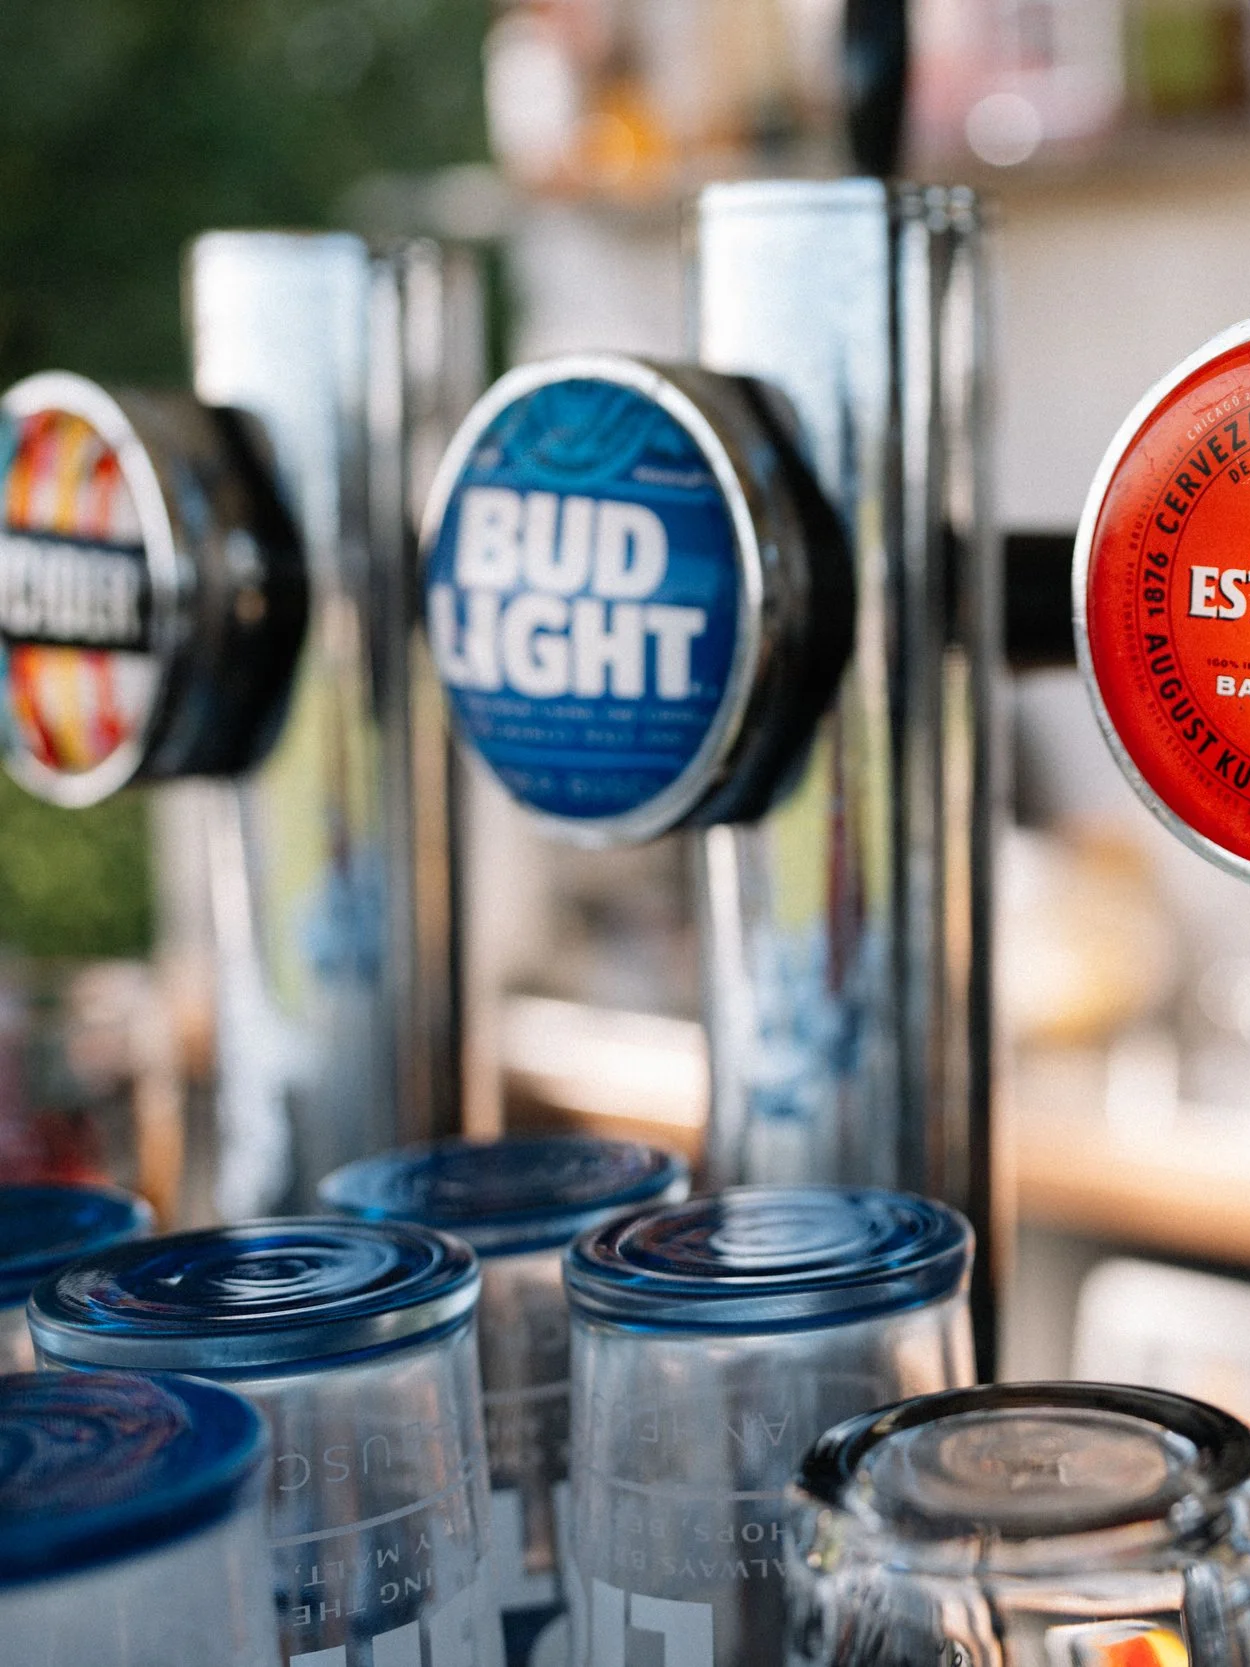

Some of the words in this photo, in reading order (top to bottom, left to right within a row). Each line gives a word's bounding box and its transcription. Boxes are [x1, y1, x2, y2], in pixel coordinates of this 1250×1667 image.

[1187, 395, 1241, 442] CHICAGO
[1229, 464, 1250, 484] DE
[454, 484, 669, 600] BUD
[1144, 552, 1169, 616] 1876
[426, 578, 708, 701] LIGHT
[1145, 632, 1218, 755] AUGUST
[290, 1598, 366, 1627] THE
